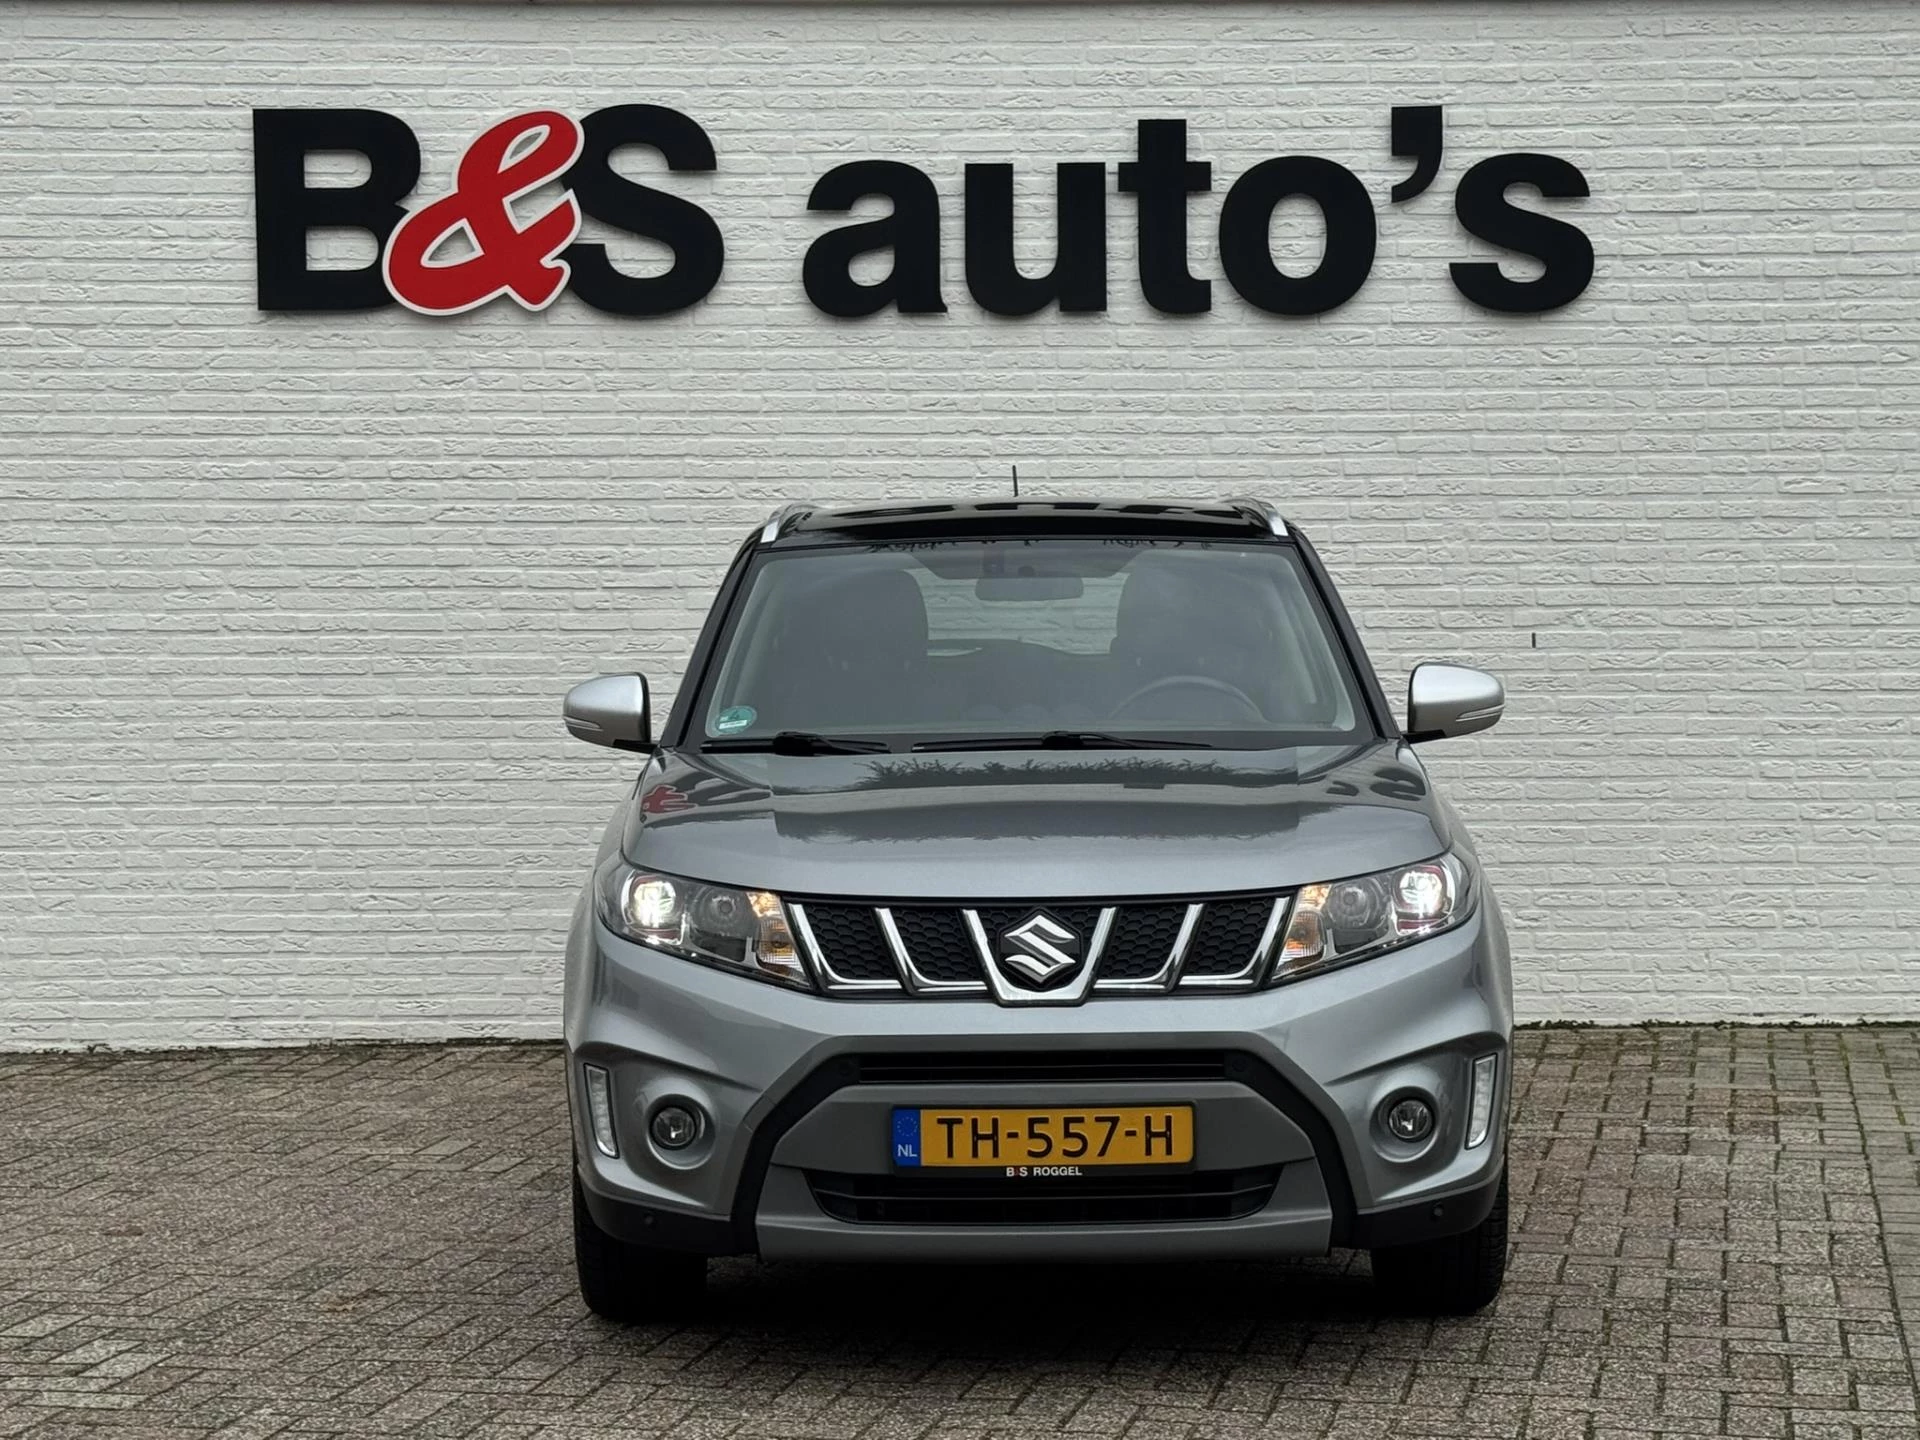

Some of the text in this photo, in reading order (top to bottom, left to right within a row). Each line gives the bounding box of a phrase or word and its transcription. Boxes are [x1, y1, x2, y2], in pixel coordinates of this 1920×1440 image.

[252, 103, 725, 316] B&S
[897, 1144, 918, 1158] NL
[936, 1115, 1173, 1159] TH-557-H
[1033, 1166, 1083, 1177] ROGGEL
